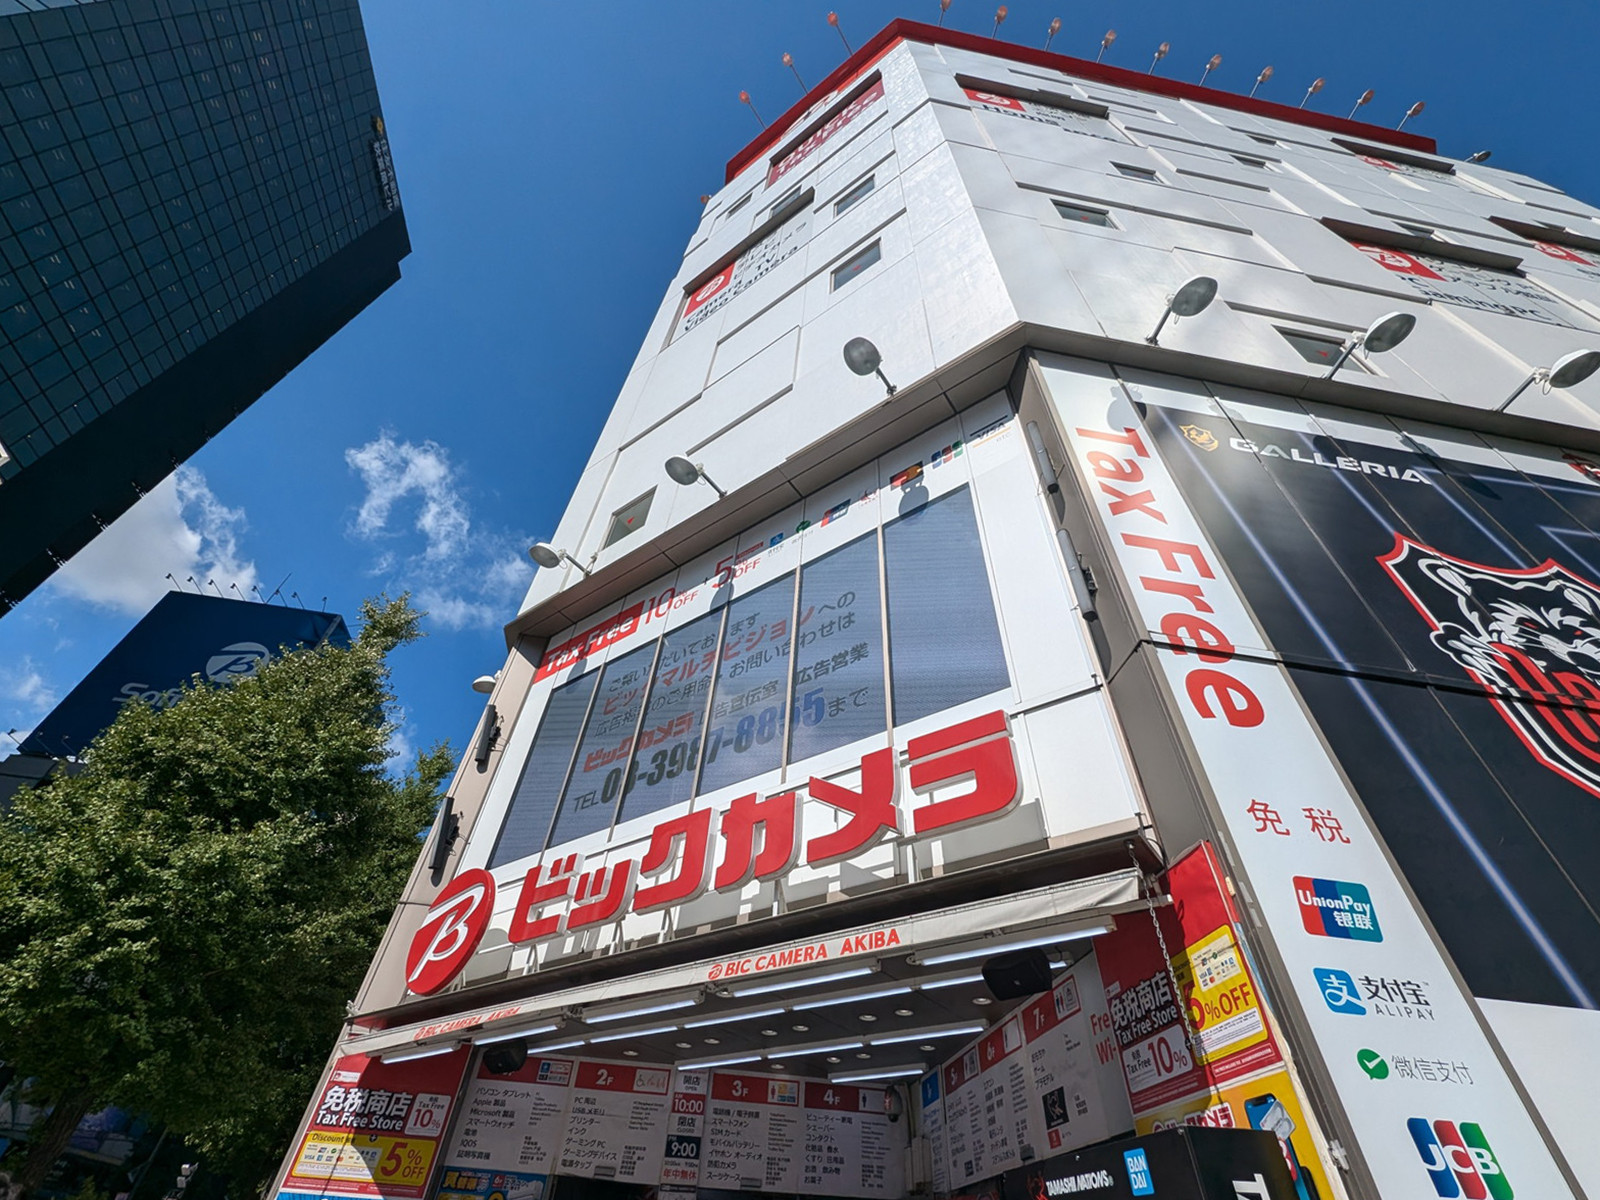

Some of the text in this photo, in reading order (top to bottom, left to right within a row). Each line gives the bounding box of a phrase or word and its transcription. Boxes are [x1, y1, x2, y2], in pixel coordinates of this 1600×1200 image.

[1229, 437, 1434, 486] GALLERIA
[1075, 426, 1265, 728] Tax Free
[545, 643, 585, 673] Tax
[583, 615, 636, 653] Free
[672, 590, 700, 611] OFF
[733, 557, 761, 578] OFF
[608, 612, 762, 692] ご覧いだいておます
[699, 680, 779, 727] 告宣伝室
[574, 789, 600, 812] TEL
[508, 710, 1022, 945] ビックカメラ
[1246, 798, 1351, 845] 免税
[1297, 889, 1372, 920] UnionPay
[1332, 910, 1374, 932] 银联
[724, 928, 901, 977] BIC CAMERA AKIBA
[1110, 971, 1173, 1030] 免税商店
[1358, 975, 1431, 1007] 支付宝
[443, 1015, 484, 1034] CAMERA
[1090, 1013, 1111, 1036] Fre
[1115, 1004, 1178, 1045] Tax Free Store
[1374, 1006, 1436, 1021] ALIPAY
[1096, 1037, 1116, 1065] Wi-
[595, 1068, 614, 1086] 2F
[1391, 1054, 1475, 1086] 微信支付
[732, 1079, 749, 1097] 3F
[823, 1089, 841, 1105] 4F
[320, 1085, 413, 1118] 免税商店
[431, 1102, 445, 1110] Free
[469, 1108, 502, 1118] Microsoft
[472, 1098, 492, 1108] Apple
[674, 1099, 703, 1113] 10:00
[316, 1110, 404, 1131] Tax Free Store
[711, 1118, 750, 1128] スマートフォン
[311, 1133, 345, 1143] Discount
[671, 1143, 697, 1157] 9:00
[1420, 1143, 1501, 1175] JCB
[402, 1166, 426, 1180] OFF
[663, 1168, 697, 1180] 年中無休
[1126, 1154, 1148, 1173] BAN
[1045, 1169, 1110, 1197] TAMASHII NATIONS
[1130, 1172, 1148, 1190] DAI
